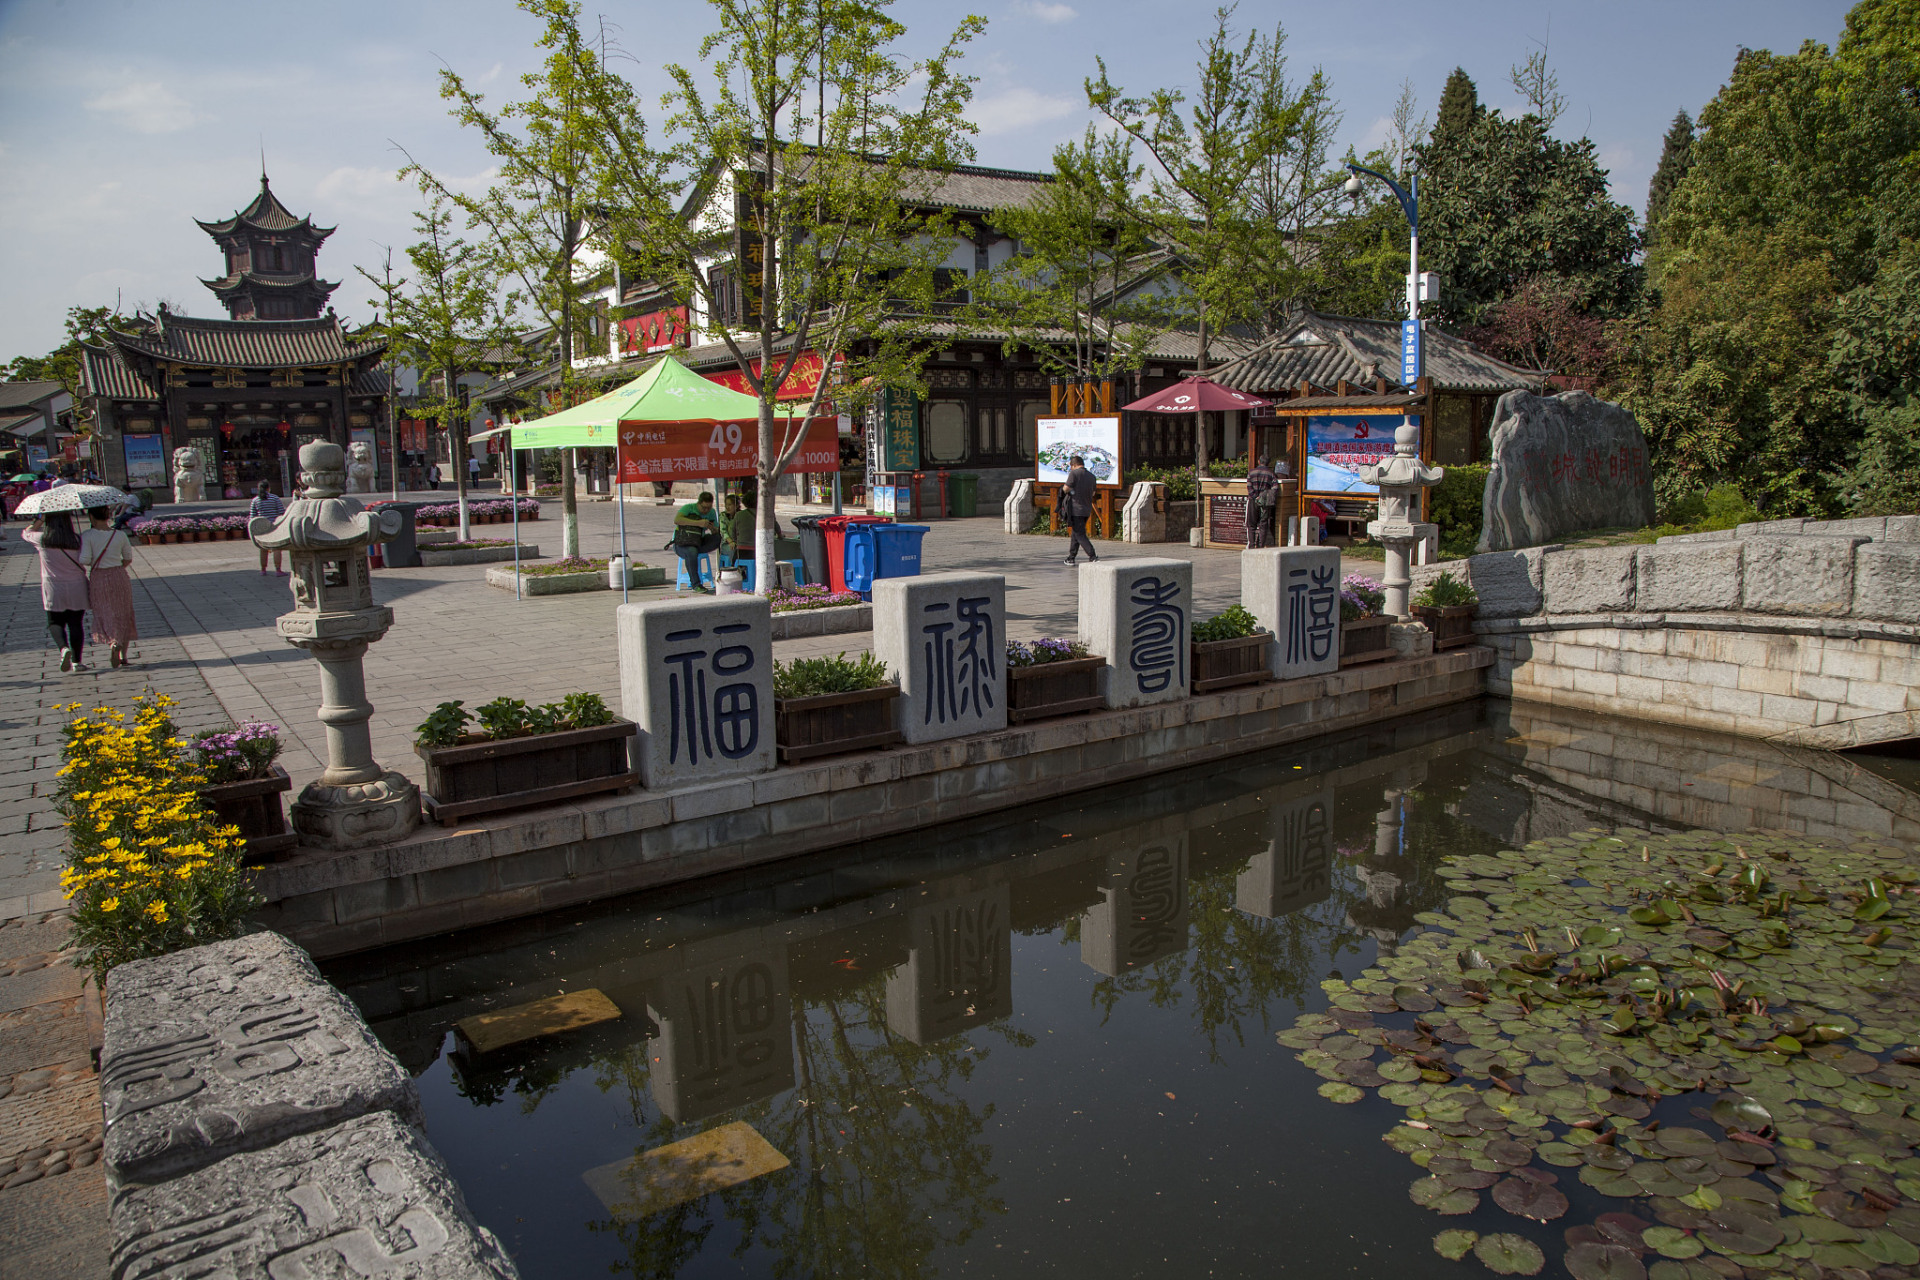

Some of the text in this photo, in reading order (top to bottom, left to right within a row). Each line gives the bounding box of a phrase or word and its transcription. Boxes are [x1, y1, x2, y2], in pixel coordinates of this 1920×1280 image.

[1404, 324, 1416, 384] 电子监控区域
[709, 424, 742, 455] 49
[805, 451, 830, 464] 1000
[1328, 454, 1393, 465] 党群活动服务
[664, 624, 757, 765] 福
